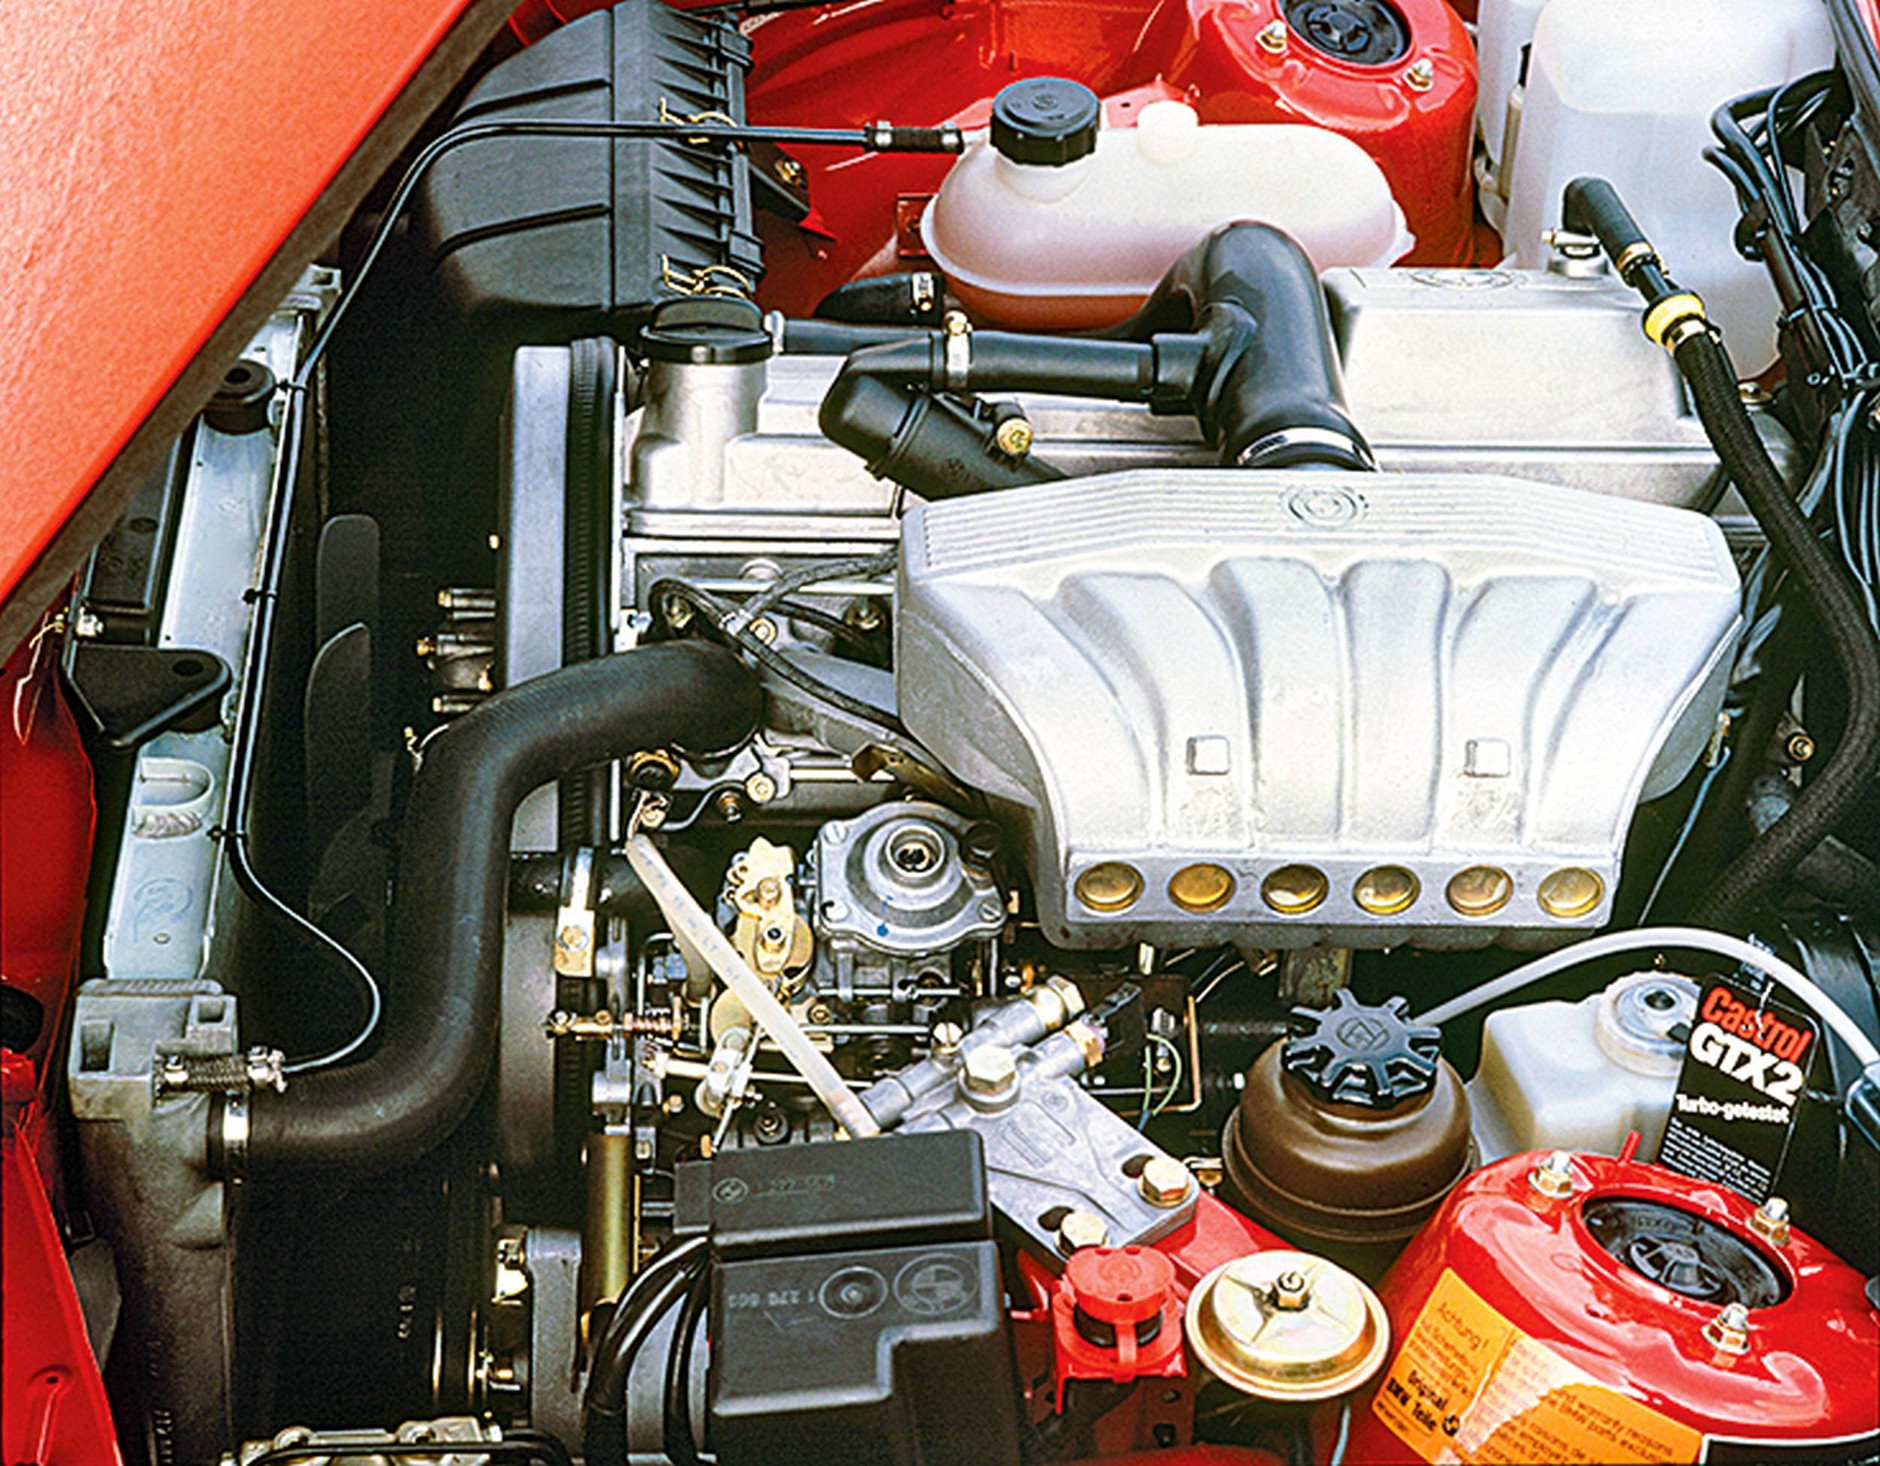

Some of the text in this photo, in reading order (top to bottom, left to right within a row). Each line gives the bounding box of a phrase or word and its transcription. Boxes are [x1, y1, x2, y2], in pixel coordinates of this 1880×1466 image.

[1690, 1022, 1803, 1107] GTX2
[1701, 986, 1812, 1065] Castrol
[1408, 1370, 1449, 1411] Original
